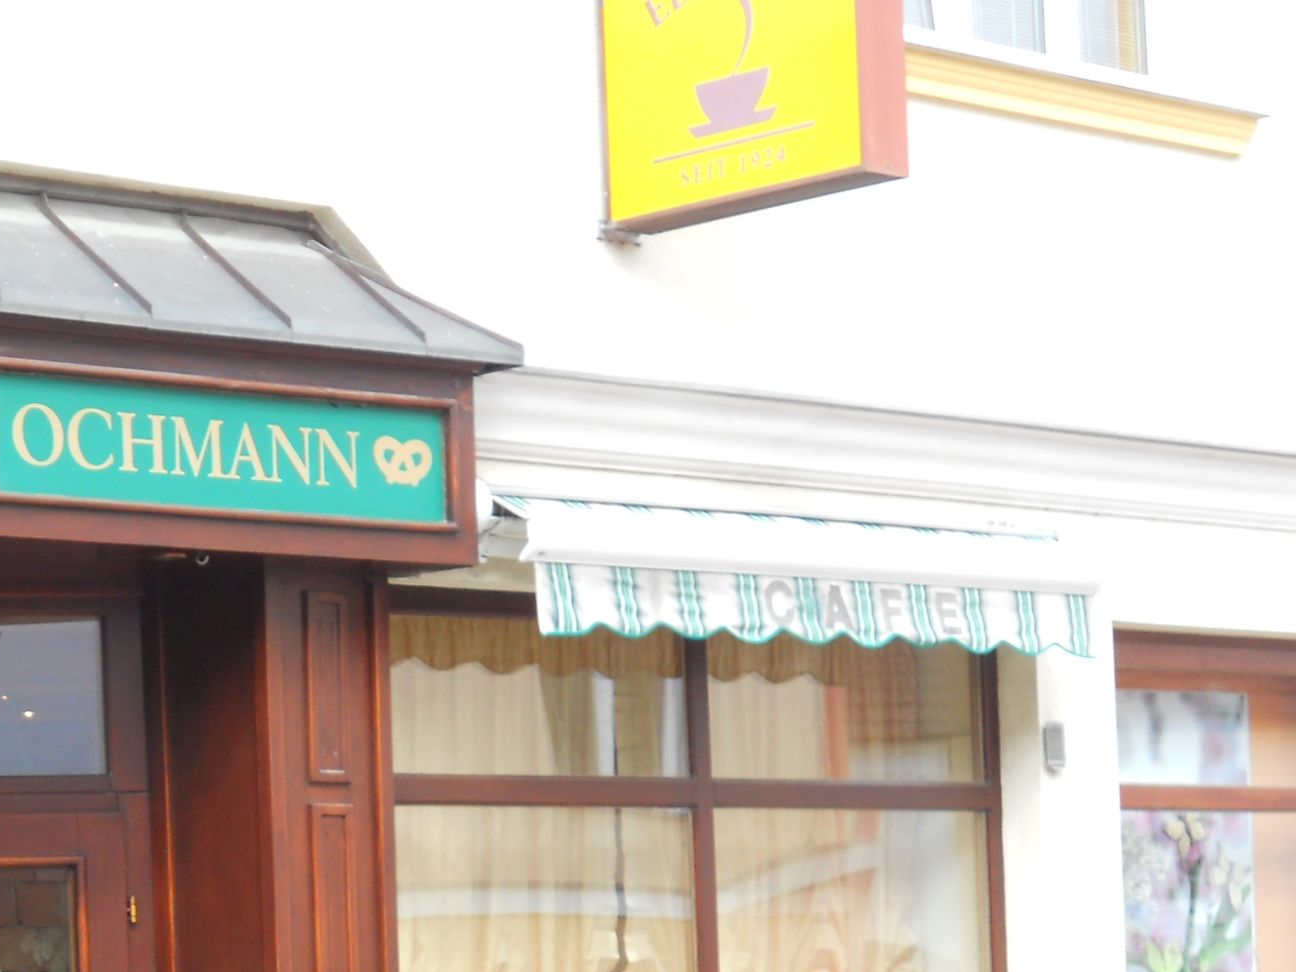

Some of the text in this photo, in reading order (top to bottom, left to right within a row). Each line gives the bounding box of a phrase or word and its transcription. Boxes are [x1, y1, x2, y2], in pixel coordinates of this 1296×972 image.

[680, 145, 787, 188] SEIT 1924
[11, 401, 361, 490] OCHMANN
[762, 579, 964, 636] CAFE
